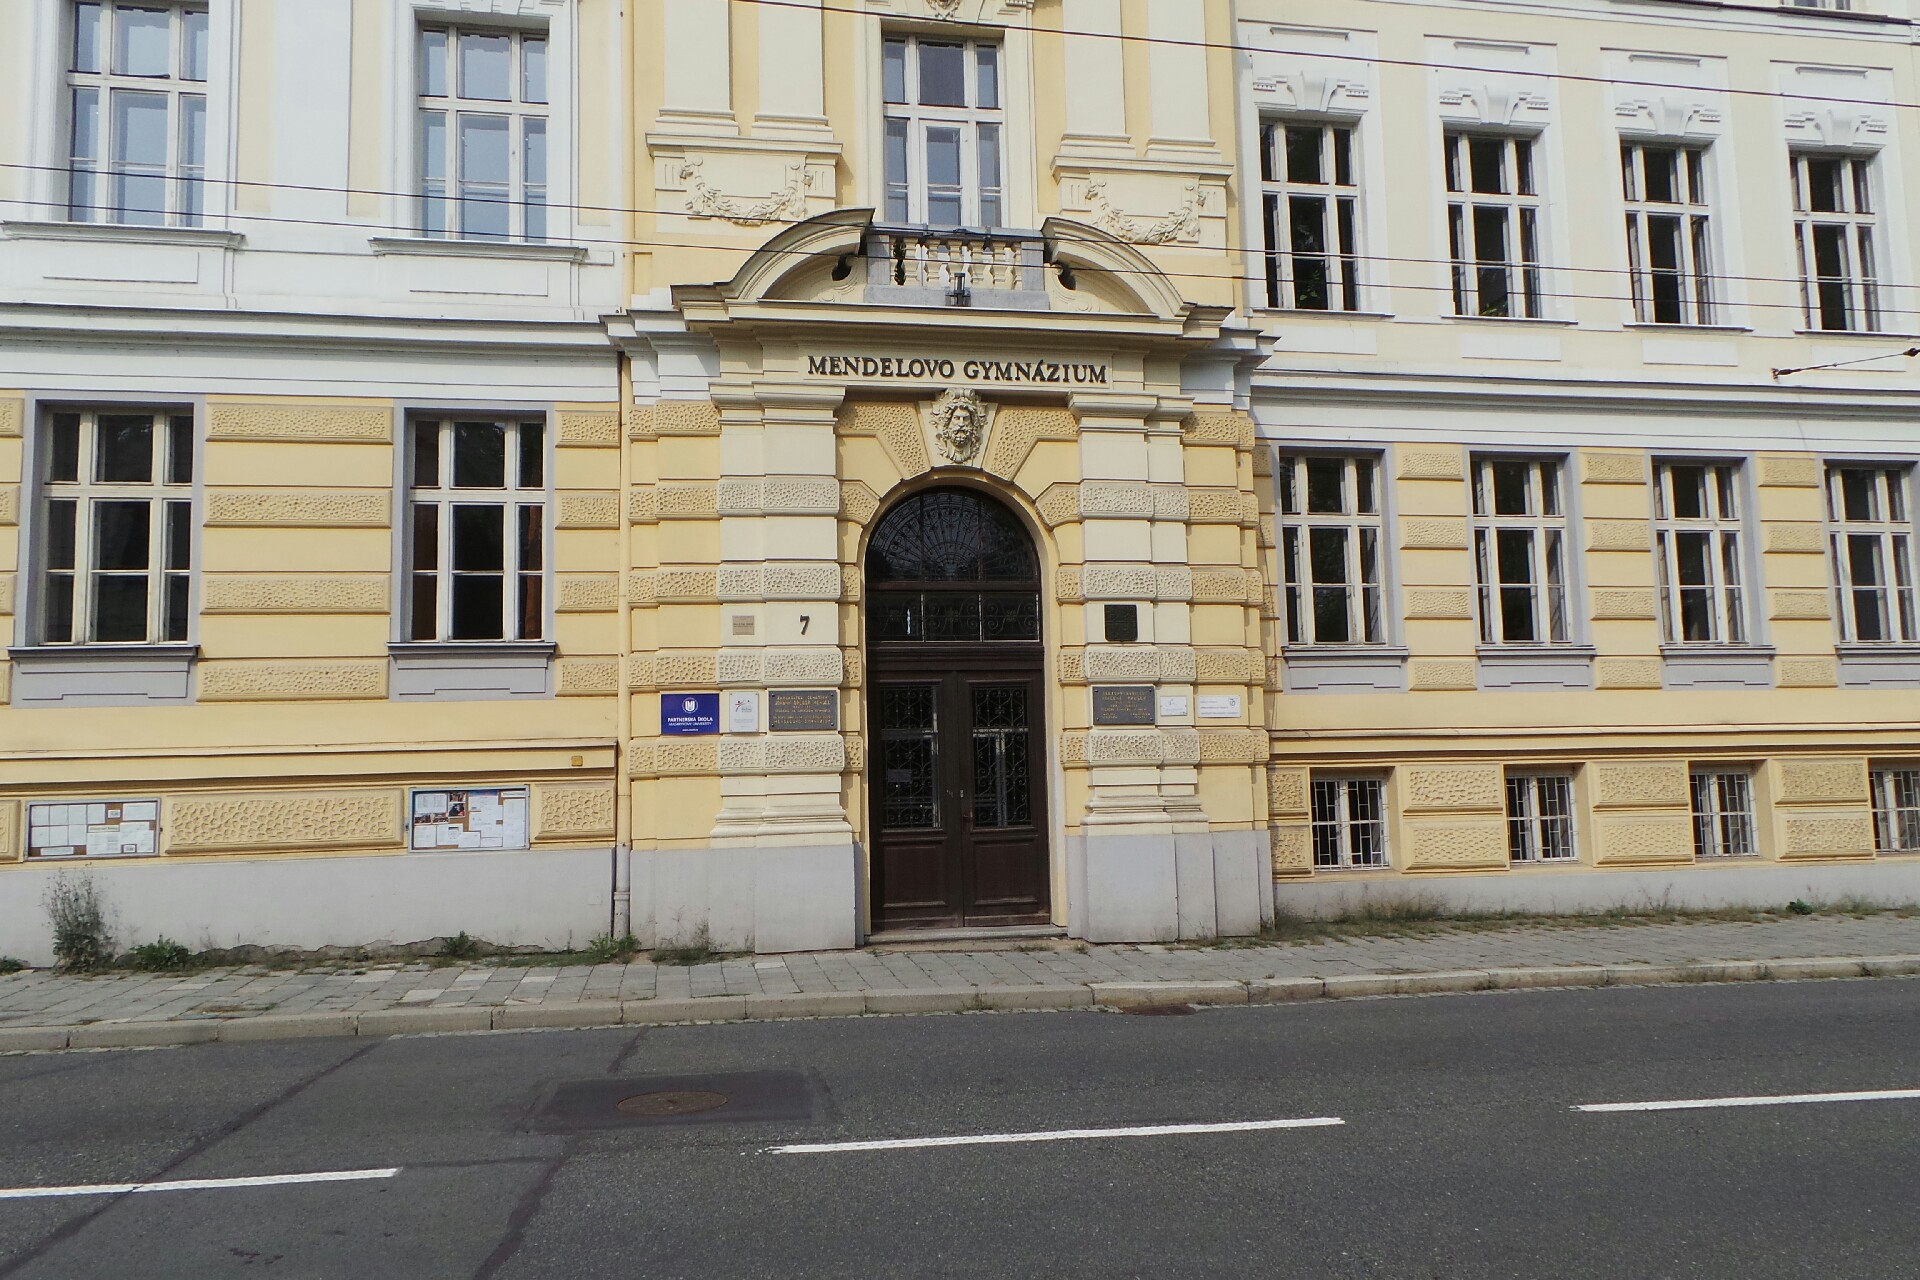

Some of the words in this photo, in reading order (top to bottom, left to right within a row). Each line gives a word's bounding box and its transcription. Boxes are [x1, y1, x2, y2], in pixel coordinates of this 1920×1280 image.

[808, 355, 954, 379] MENDELOVO
[964, 359, 1107, 384] GYMNÁZIUM
[799, 614, 810, 636] 7
